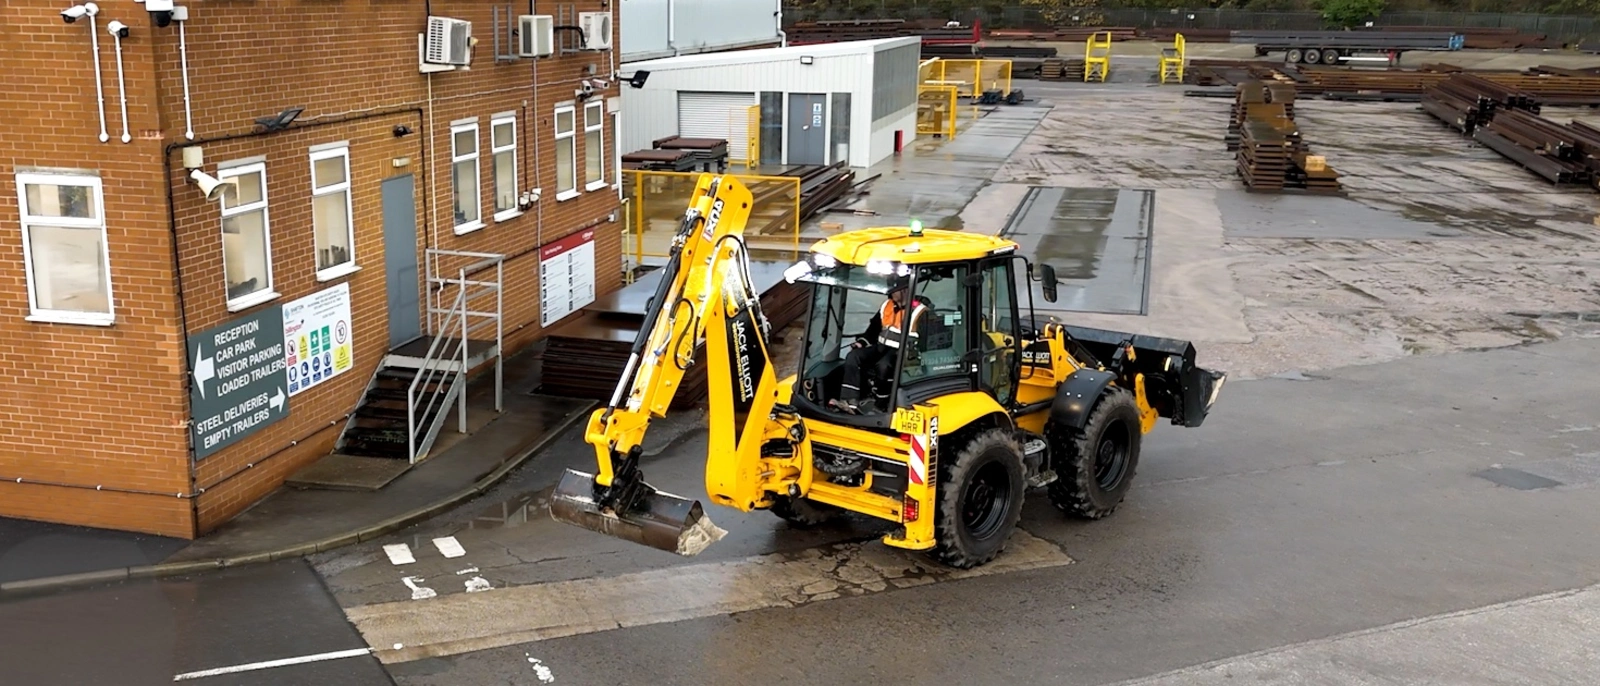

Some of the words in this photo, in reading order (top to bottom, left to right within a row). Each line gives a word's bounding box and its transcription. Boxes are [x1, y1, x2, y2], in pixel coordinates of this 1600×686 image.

[214, 319, 259, 346] RECEPTION
[736, 320, 748, 353] JACK
[216, 346, 234, 362] CAR
[234, 337, 257, 356] PARK
[216, 357, 249, 379] VISITOR
[249, 343, 282, 366] PARKING
[217, 373, 250, 397] LOADED
[250, 357, 286, 382] TRAILERS
[741, 354, 754, 398] ELLIOTT
[196, 414, 224, 435] STEEL
[224, 392, 269, 422] DELIVERIES
[204, 425, 232, 450] EMPTY
[232, 408, 270, 435] TRAILERS
[899, 410, 921, 422] YT25
[901, 421, 918, 433] HRR
[930, 416, 938, 447] 4CX
